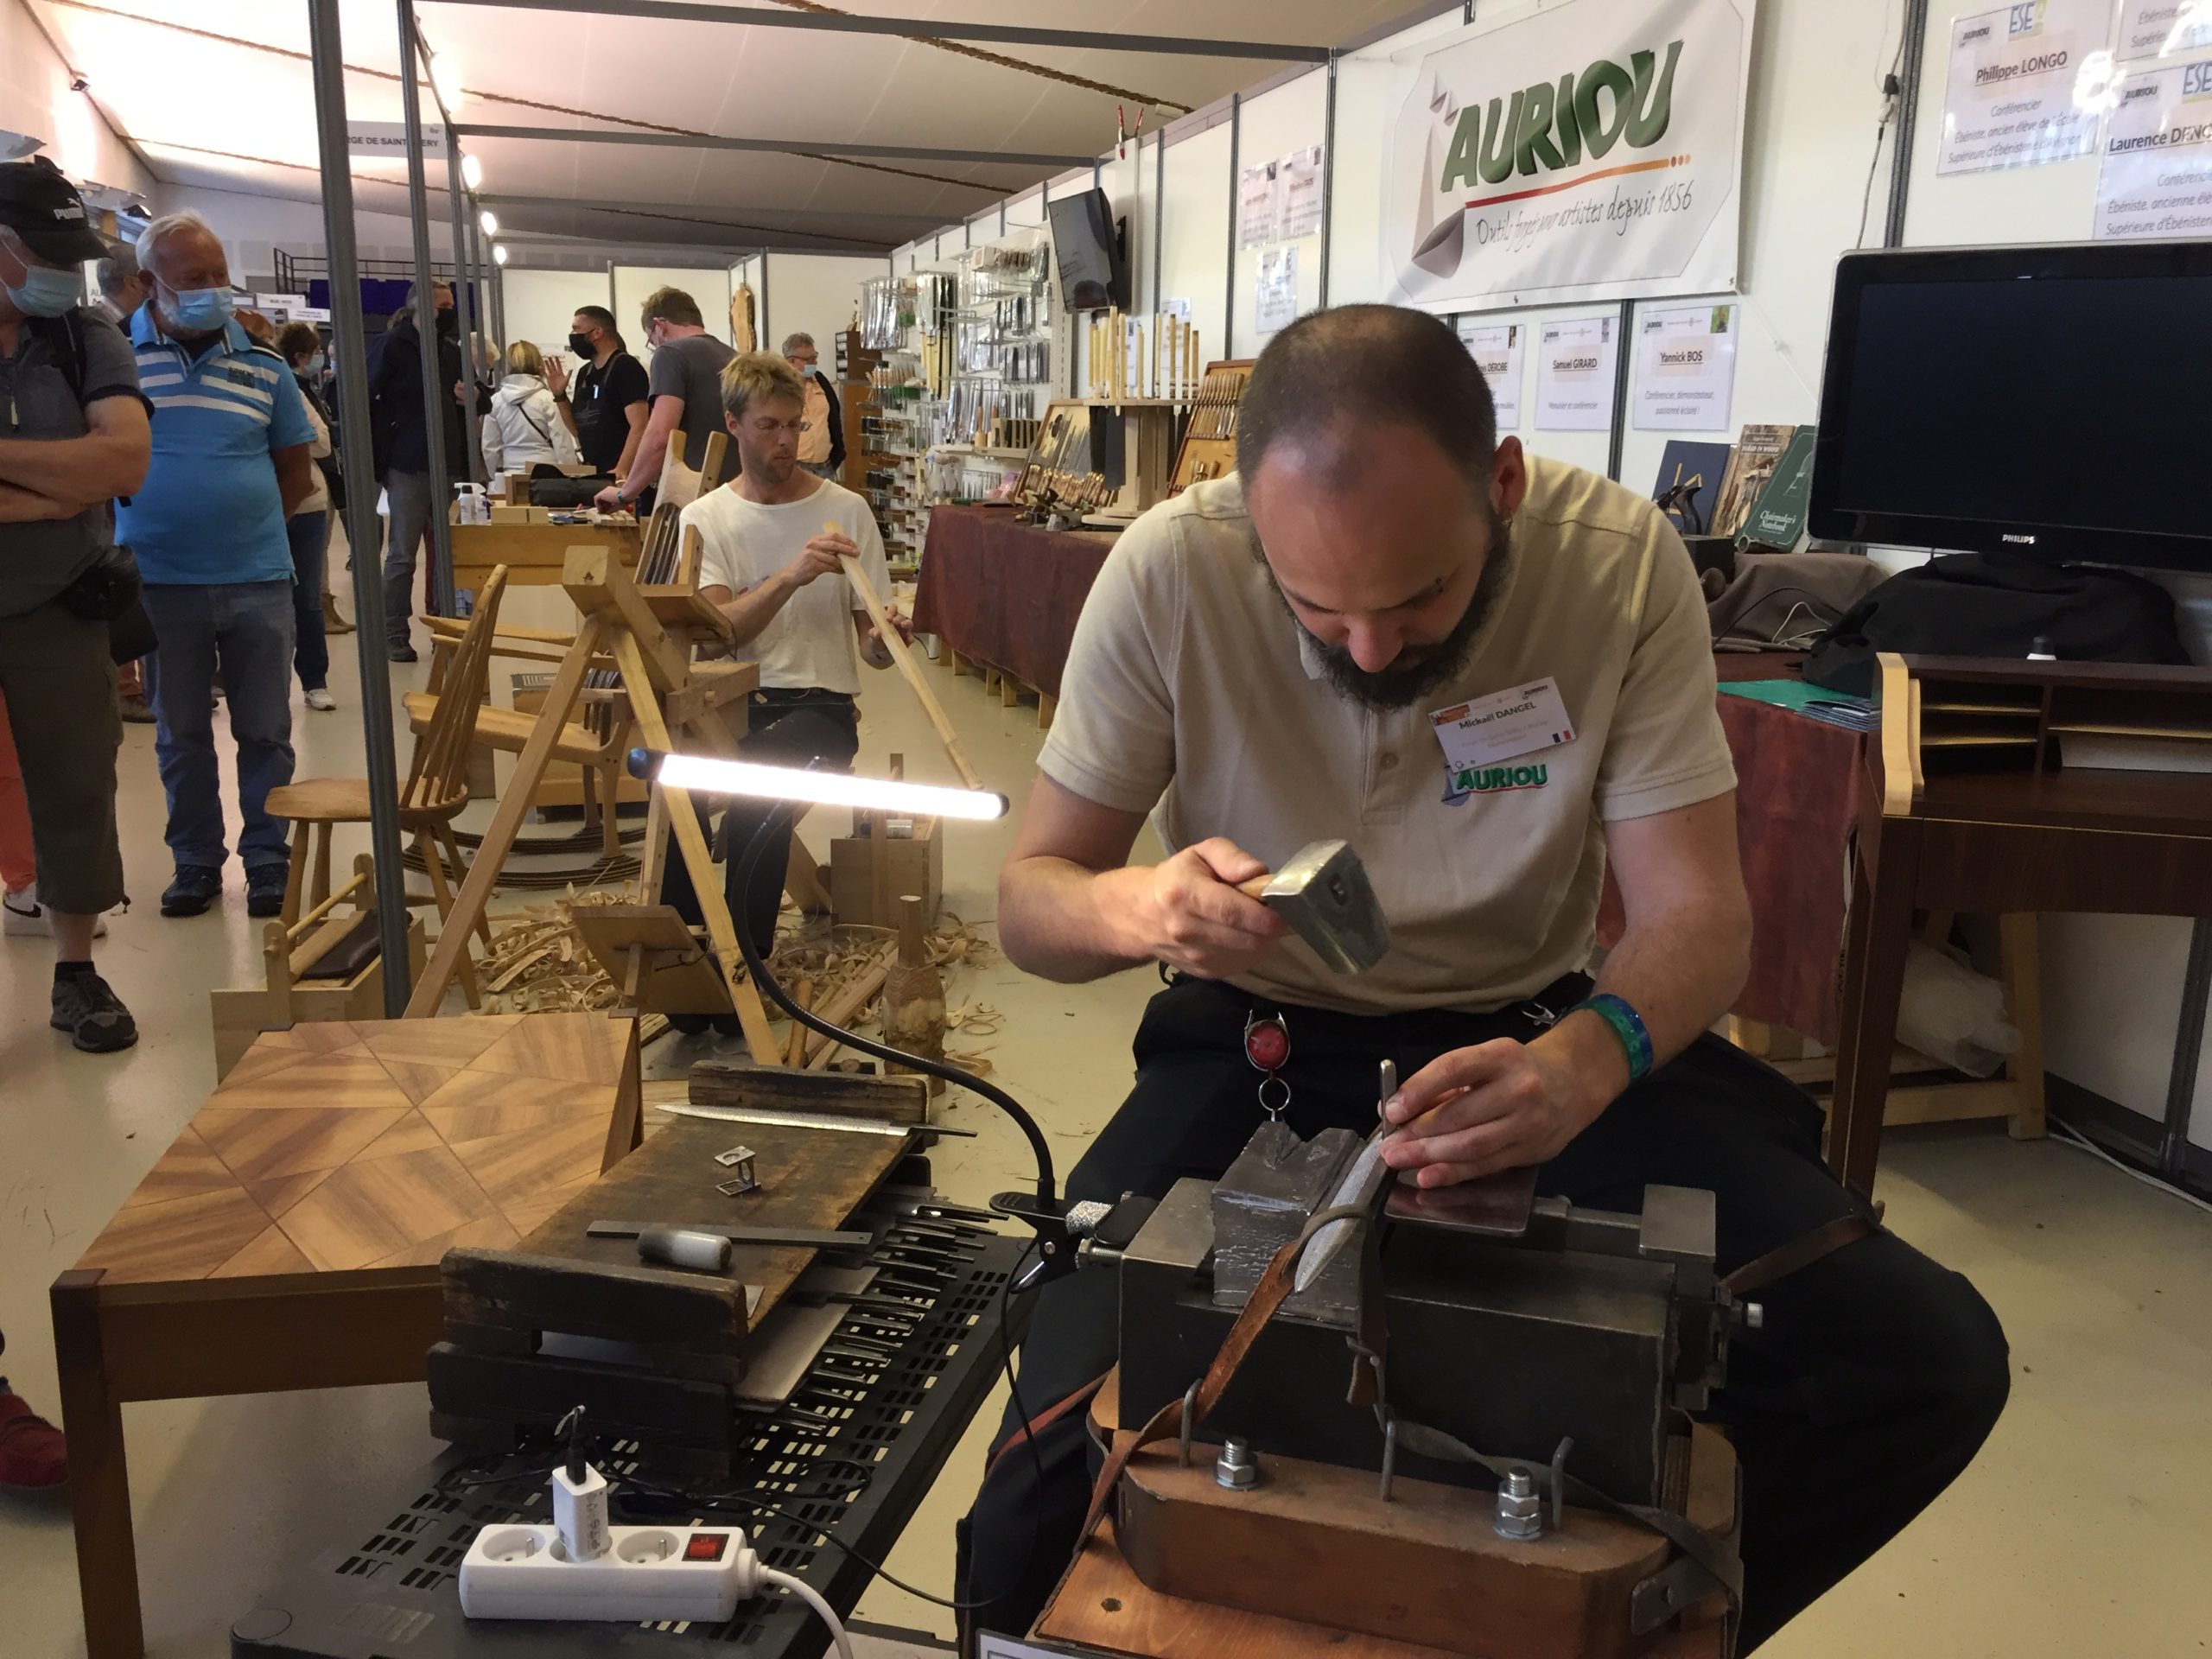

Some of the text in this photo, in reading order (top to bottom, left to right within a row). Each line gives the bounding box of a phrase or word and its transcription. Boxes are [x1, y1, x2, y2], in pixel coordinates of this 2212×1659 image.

[1976, 51, 2068, 84] Philippe LONGO
[1440, 40, 1683, 194] AURIOU
[365, 137, 378, 145] DE
[2109, 134, 2167, 152] Laurence
[1607, 185, 1656, 236] depuis
[1658, 180, 1695, 213] 1856
[2108, 198, 2149, 214] Ébéniste,
[2151, 195, 2195, 210] ancienne
[2106, 221, 2155, 236] Supérieure
[1553, 358, 1598, 370] Samuel GIRARD
[1660, 350, 1703, 363] Yannick BOS
[1762, 518, 1788, 532] Notebook
[2002, 534, 2036, 544] PHILIPS
[1459, 714, 1496, 729] Mickaël
[1495, 702, 1537, 720] DANGEL
[1456, 764, 1548, 790] AURIOU
